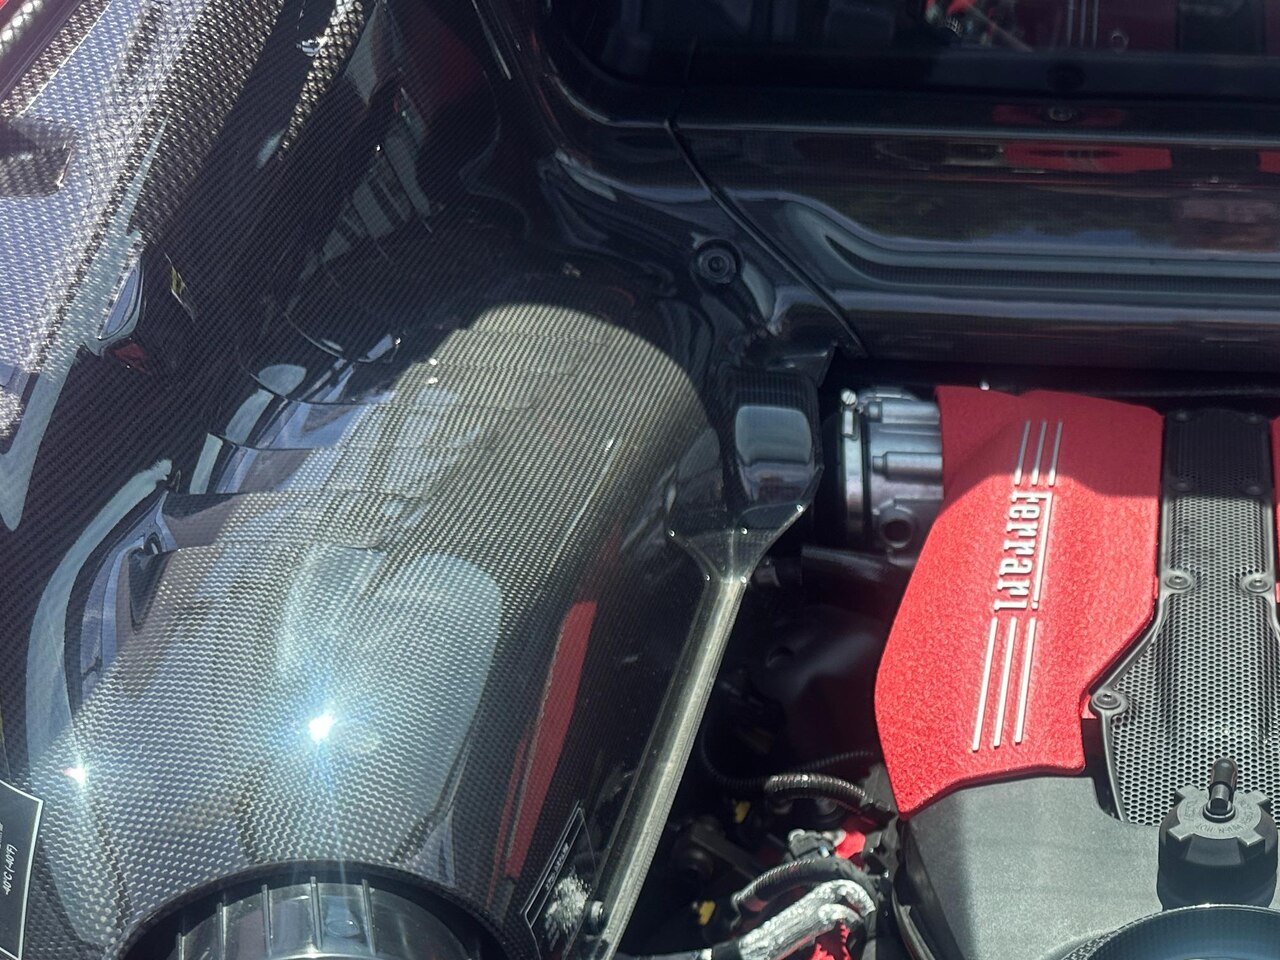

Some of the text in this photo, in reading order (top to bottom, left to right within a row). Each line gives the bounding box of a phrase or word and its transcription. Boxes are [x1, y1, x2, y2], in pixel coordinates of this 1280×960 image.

[992, 490, 1055, 611] Ferrari
[3, 844, 17, 895] -40°C (-40°F)
